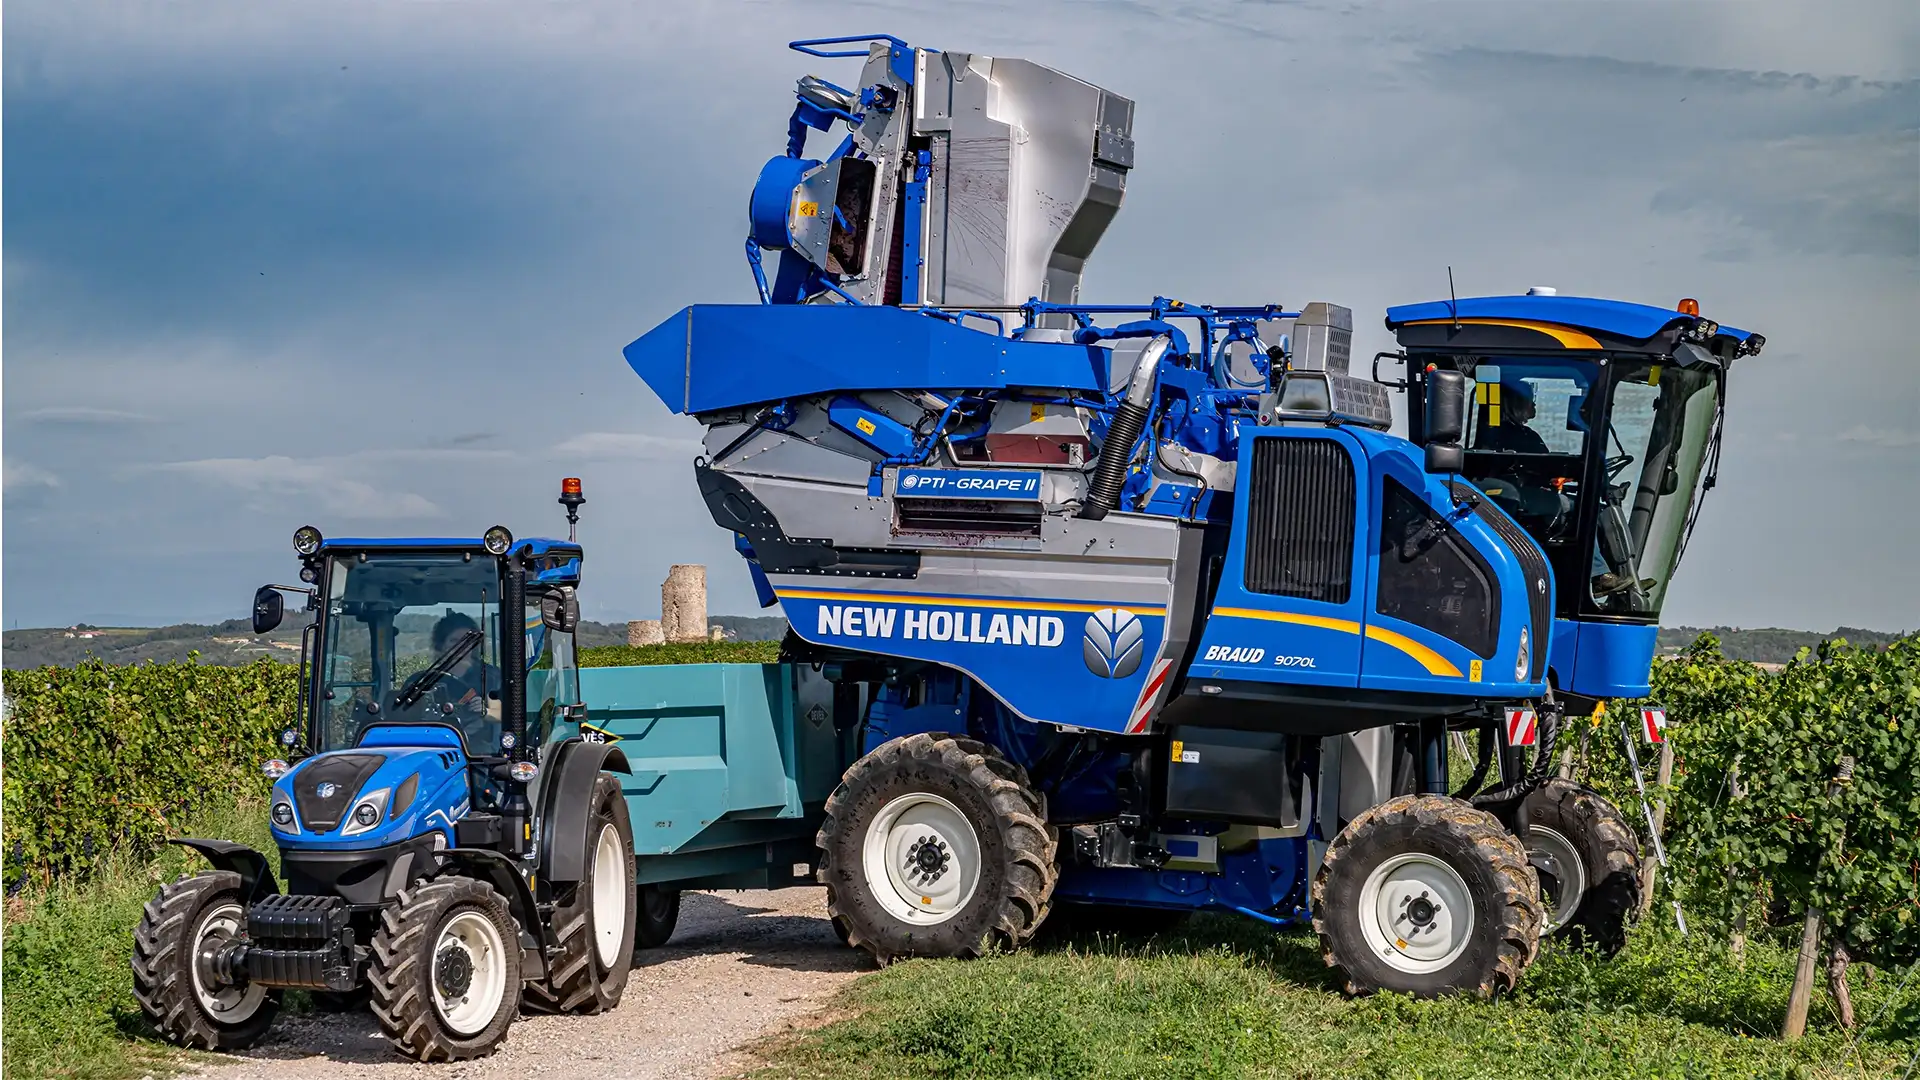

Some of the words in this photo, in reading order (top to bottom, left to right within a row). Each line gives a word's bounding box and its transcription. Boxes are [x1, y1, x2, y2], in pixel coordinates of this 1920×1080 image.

[818, 605, 896, 638] NEW
[903, 609, 1065, 647] HOLLAND
[1204, 645, 1265, 663] BRAUD
[1274, 655, 1317, 668] 9070L
